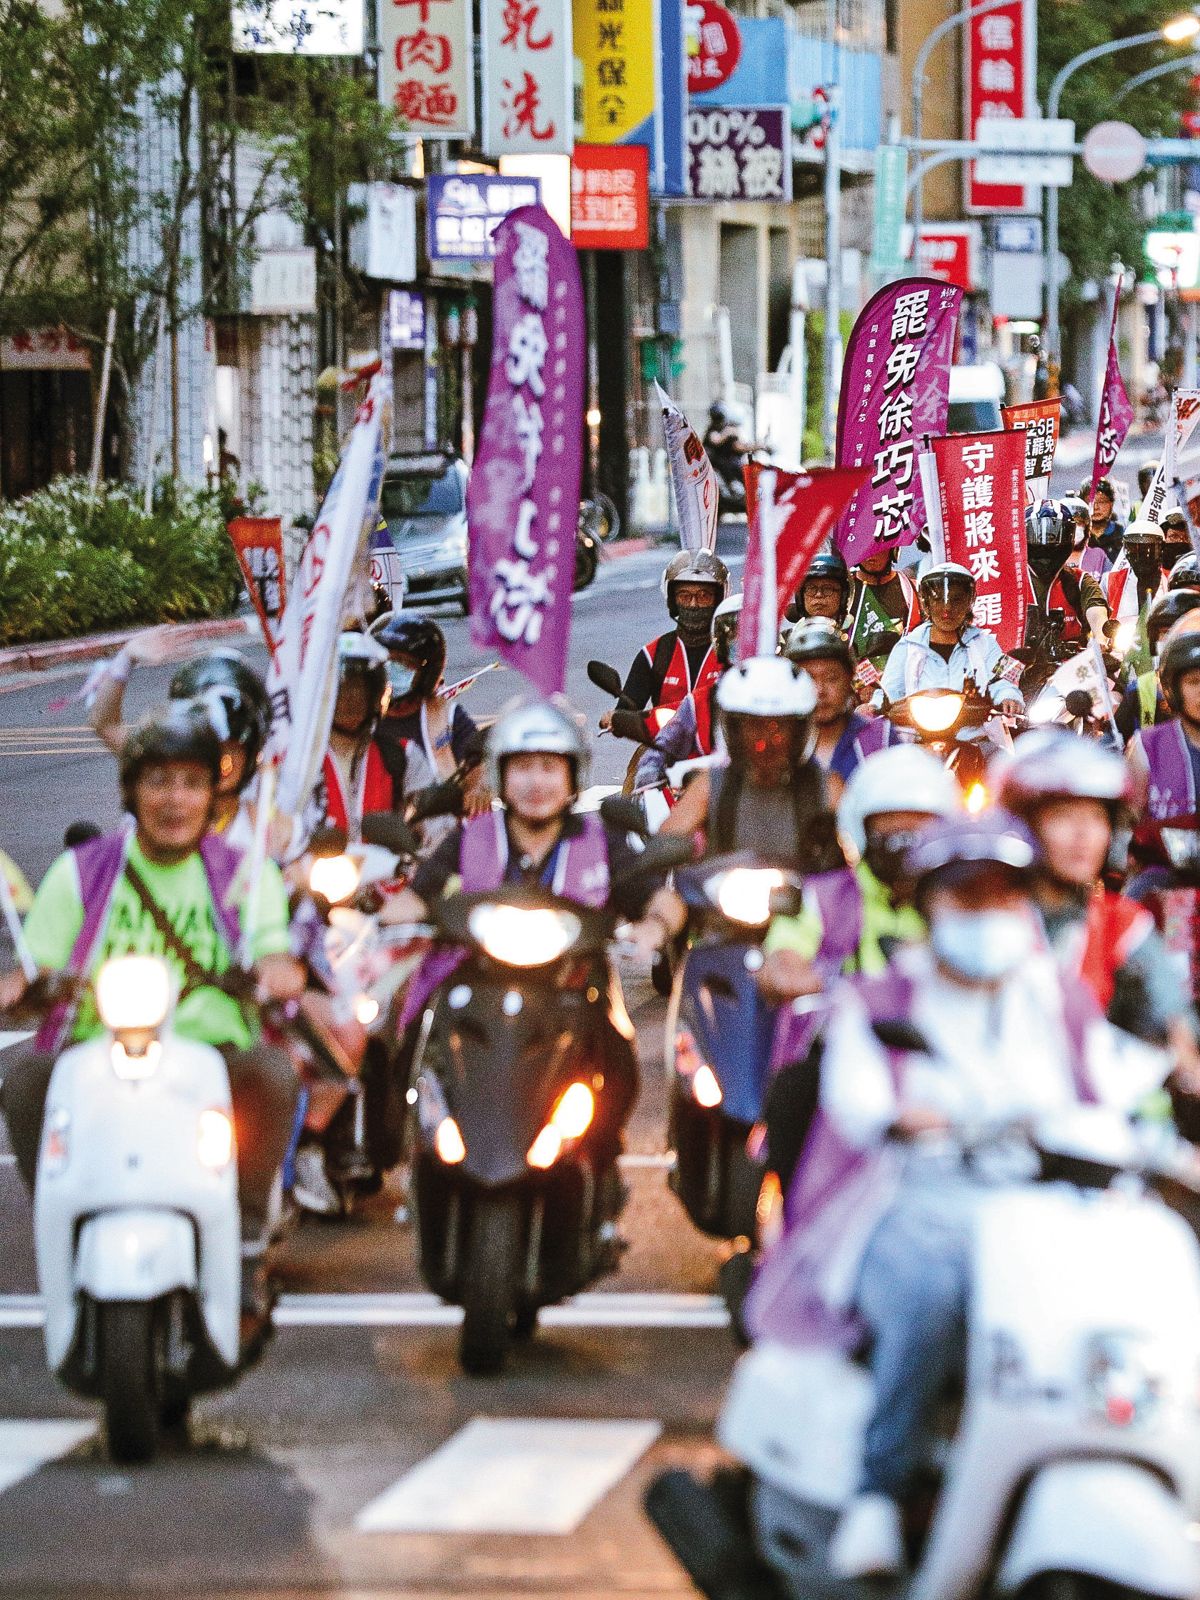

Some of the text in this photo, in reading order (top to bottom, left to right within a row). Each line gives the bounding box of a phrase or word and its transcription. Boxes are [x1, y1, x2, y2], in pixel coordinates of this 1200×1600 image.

[687, 110, 766, 145] 00%
[871, 289, 930, 541] 罷免徐巧芯
[961, 441, 1001, 582] 守護將來
